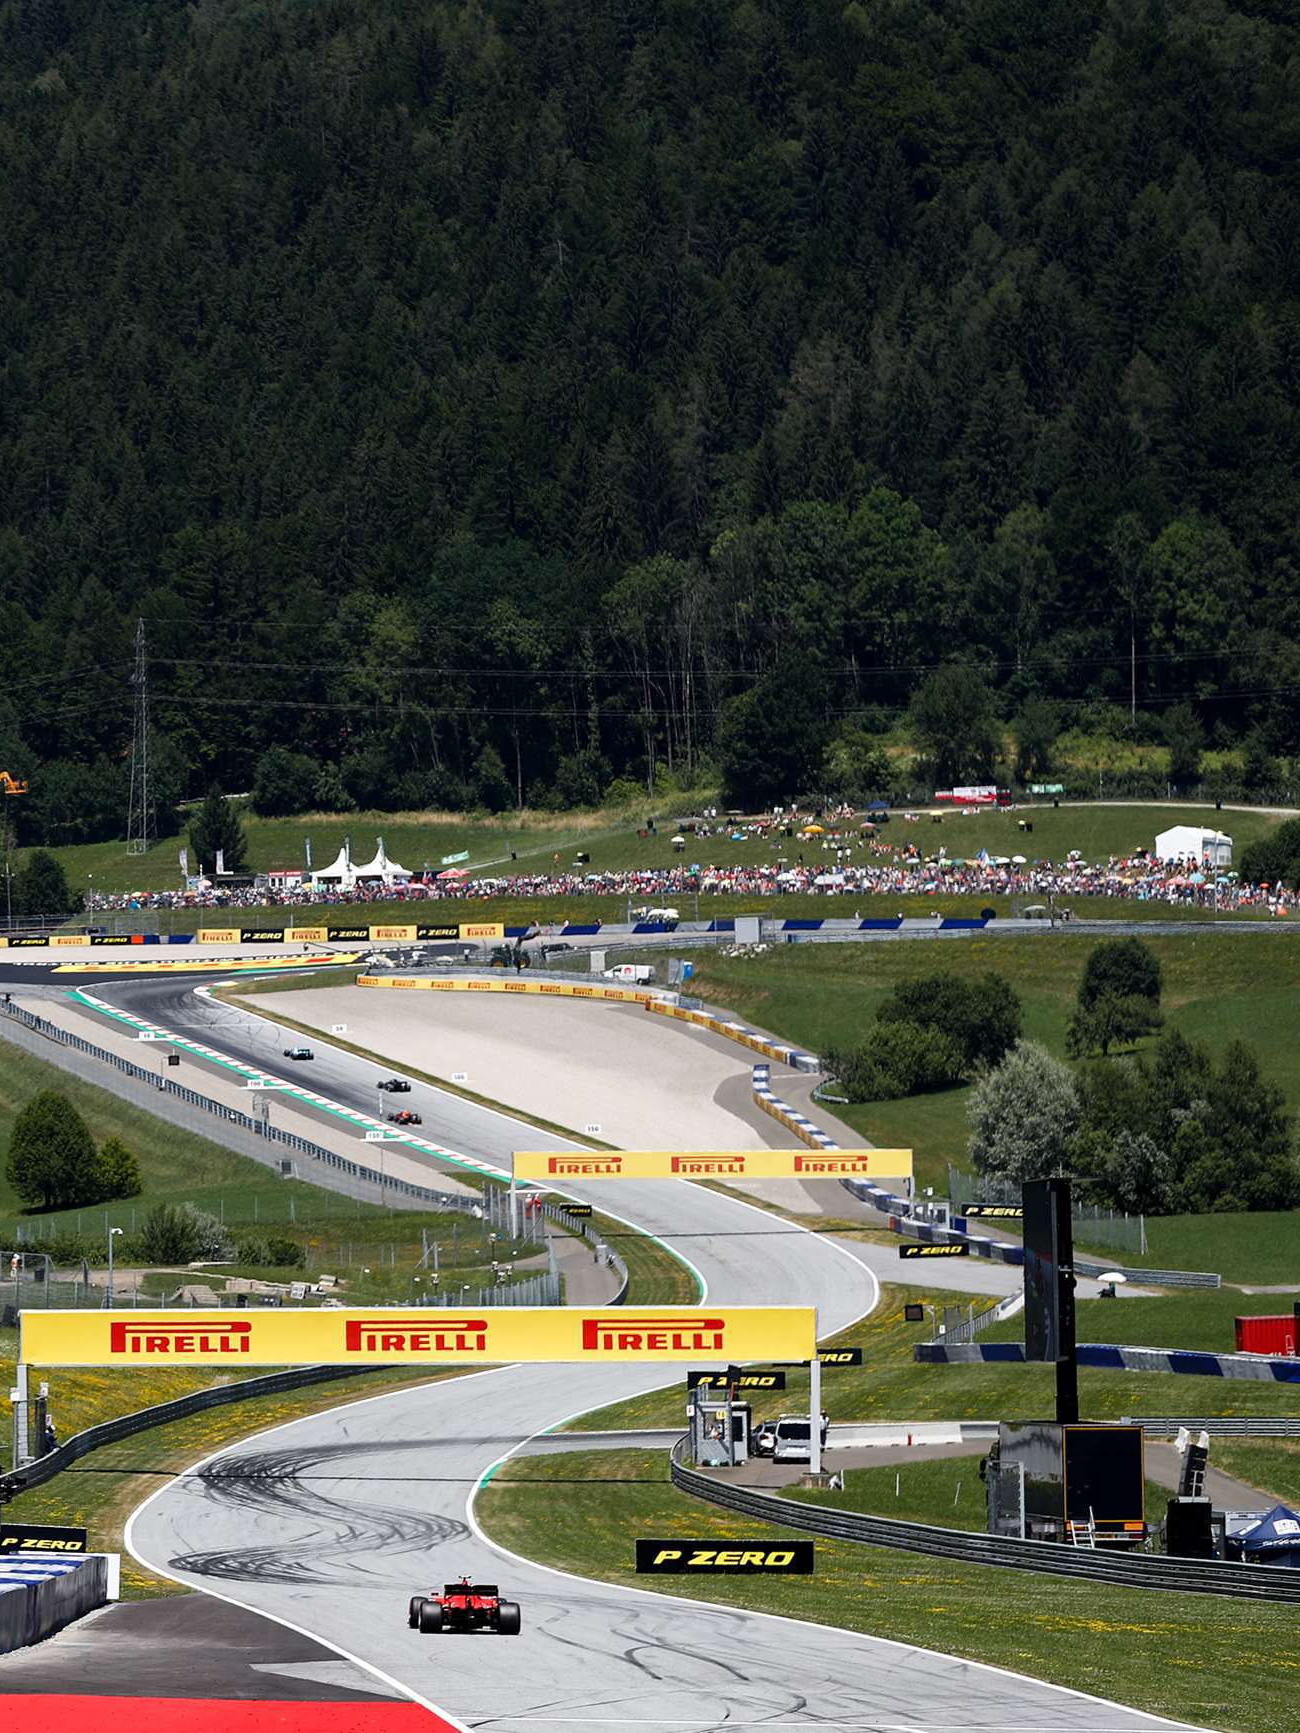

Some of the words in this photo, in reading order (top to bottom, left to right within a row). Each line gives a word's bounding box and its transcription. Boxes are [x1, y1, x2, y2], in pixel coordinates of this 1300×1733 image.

[338, 930, 368, 938] ZERO
[427, 928, 457, 936] ZERO
[548, 1156, 622, 1174] PIRELLI
[671, 1155, 745, 1173] PIRELLI
[794, 1155, 868, 1173] PIRELLI
[965, 1207, 979, 1215] P
[906, 1247, 918, 1255] P
[920, 1245, 963, 1255] ZERO
[110, 1320, 252, 1353] PIRELLI
[345, 1319, 488, 1352] PIRELLI
[582, 1318, 725, 1350] PIRELLI
[698, 1376, 714, 1386] P
[1, 1537, 18, 1546] P
[20, 1538, 83, 1550] ZERO
[653, 1550, 682, 1565] P
[687, 1551, 795, 1566] ZERO
